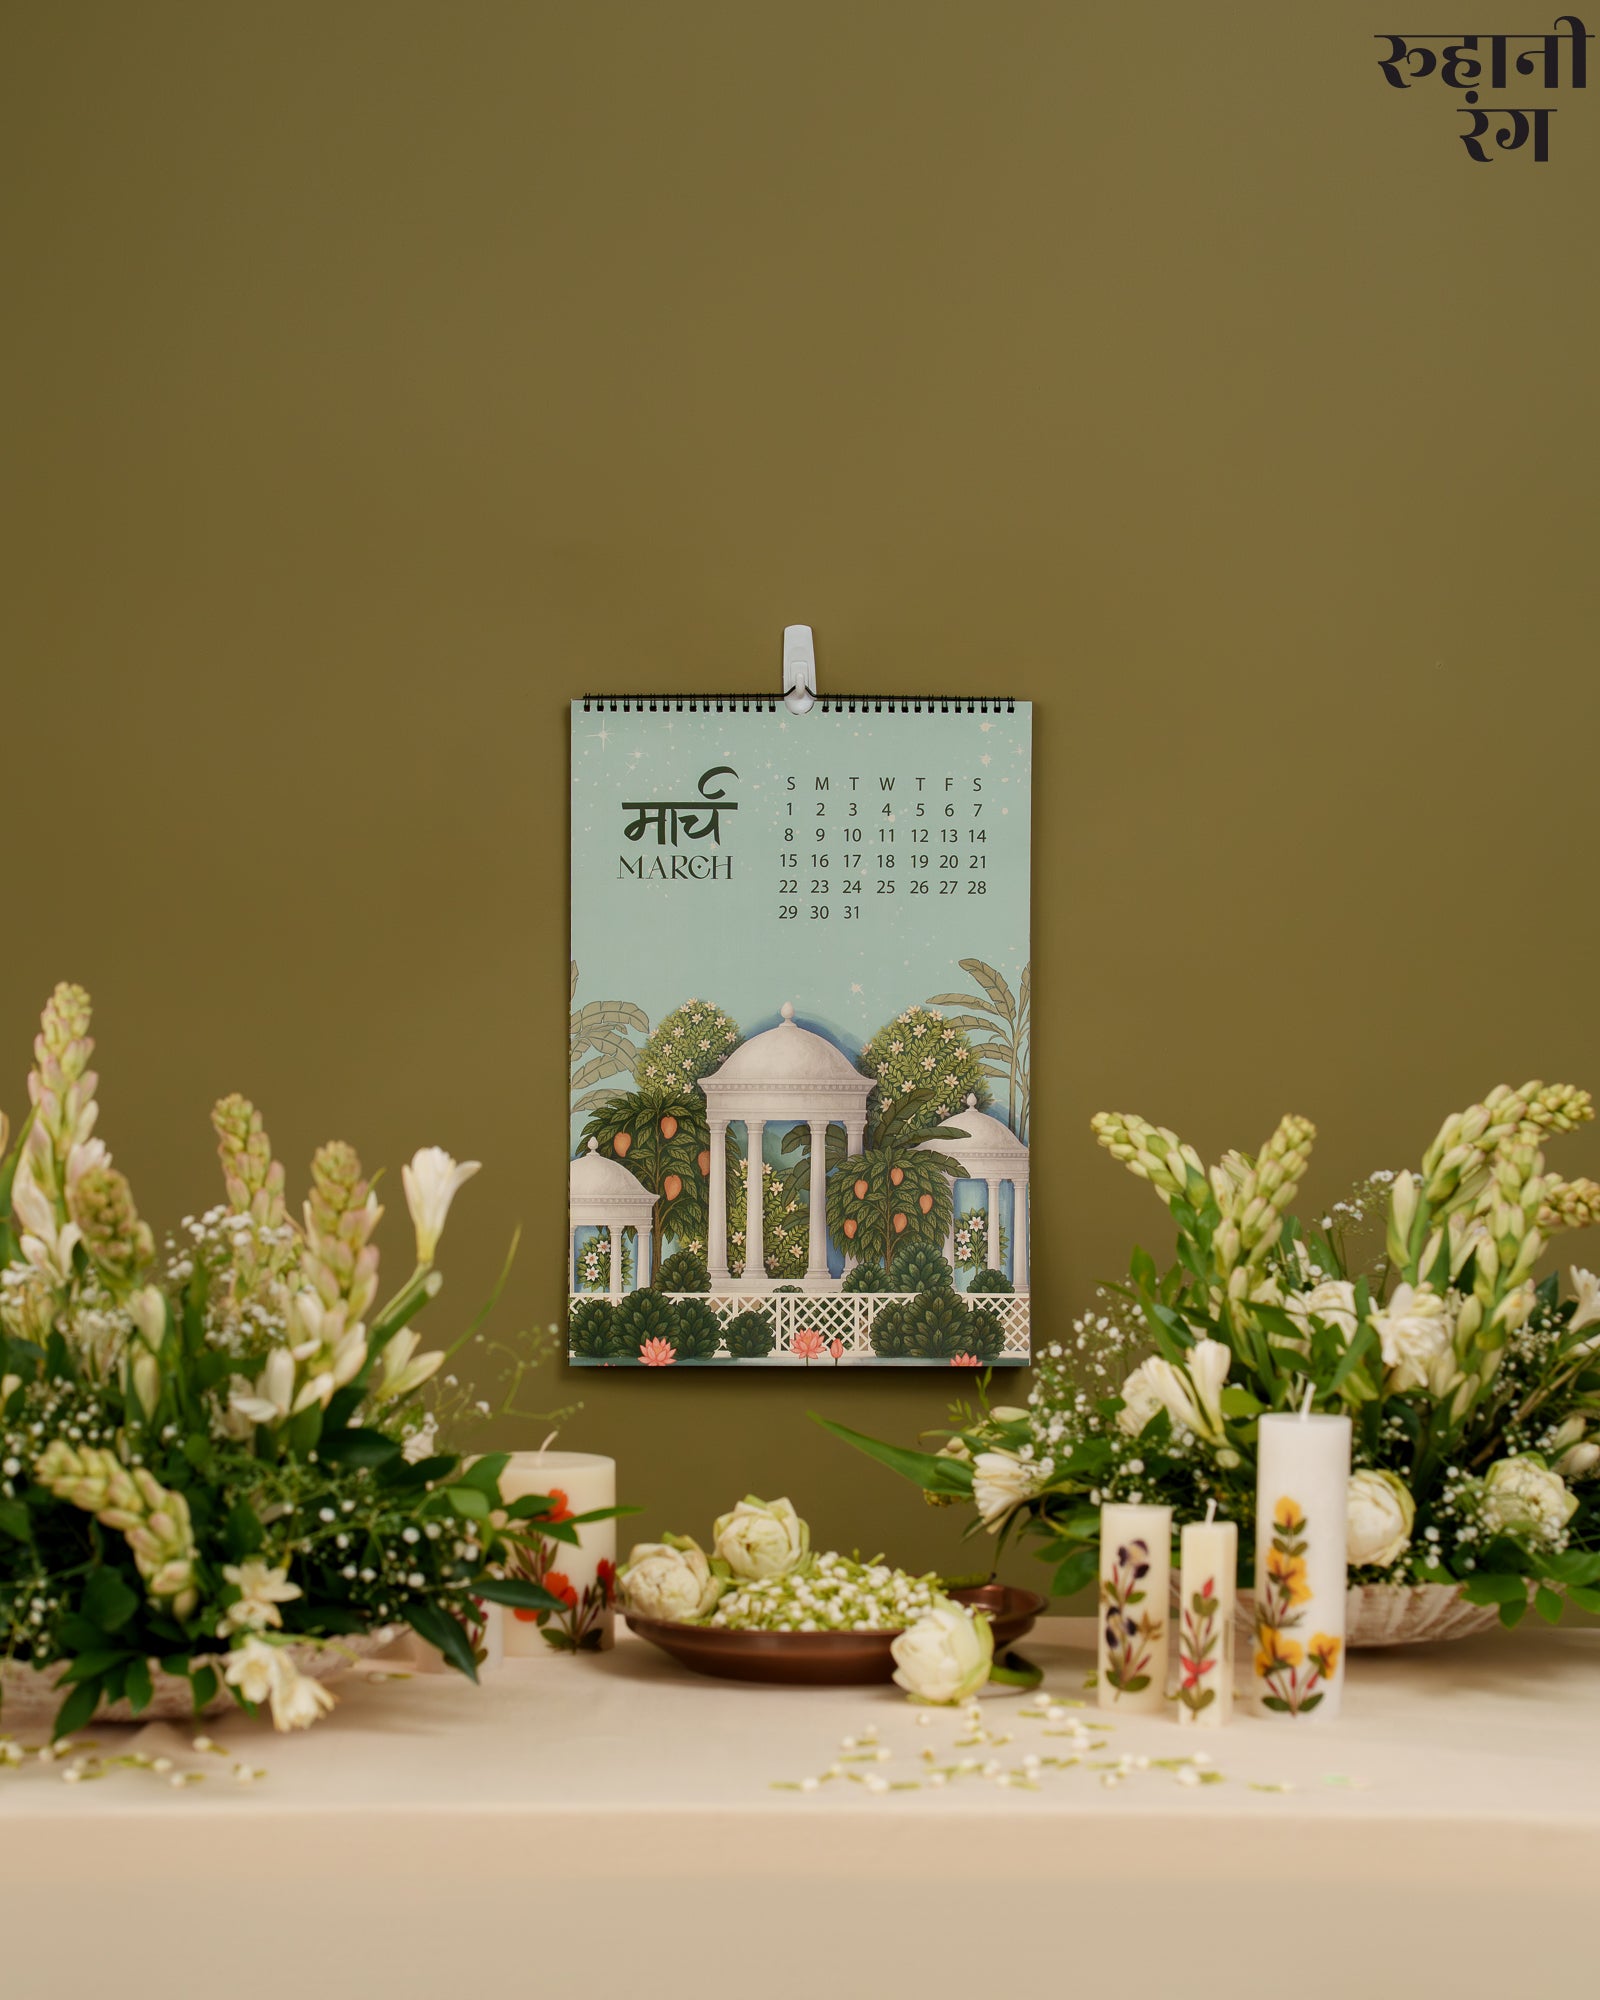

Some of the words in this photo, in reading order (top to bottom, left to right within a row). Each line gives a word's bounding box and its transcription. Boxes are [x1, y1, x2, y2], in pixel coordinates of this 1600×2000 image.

[786, 776, 796, 791] S
[815, 776, 829, 791] M
[848, 776, 860, 791] T
[879, 777, 896, 791] W
[915, 777, 926, 792] T
[945, 777, 954, 792] F
[973, 777, 982, 792] S
[621, 765, 739, 848] मार्च
[786, 802, 792, 816] 1
[816, 802, 825, 817] 2
[848, 802, 858, 817] 3
[881, 802, 892, 817] 4
[916, 803, 925, 817] 5
[944, 803, 955, 818] 6
[973, 803, 983, 817] 7
[784, 827, 794, 842] 8
[815, 828, 825, 842] 9
[843, 828, 862, 843] 10
[879, 828, 894, 843] 11
[911, 828, 929, 843] 12
[940, 828, 958, 843] 13
[968, 829, 987, 843] 14
[616, 855, 733, 880] MARCH
[780, 853, 798, 868] 15
[811, 853, 829, 868] 16
[843, 854, 862, 868] 17
[877, 854, 895, 869] 18
[910, 854, 929, 869] 19
[939, 854, 959, 869] 20
[969, 855, 986, 869] 21
[779, 879, 798, 894] 22
[810, 879, 829, 894] 23
[842, 879, 862, 894] 24
[876, 880, 895, 894] 25
[909, 880, 929, 895] 26
[939, 880, 958, 895] 27
[967, 880, 987, 895] 28
[778, 905, 798, 920] 29
[810, 905, 830, 920] 30
[843, 905, 859, 920] 31
